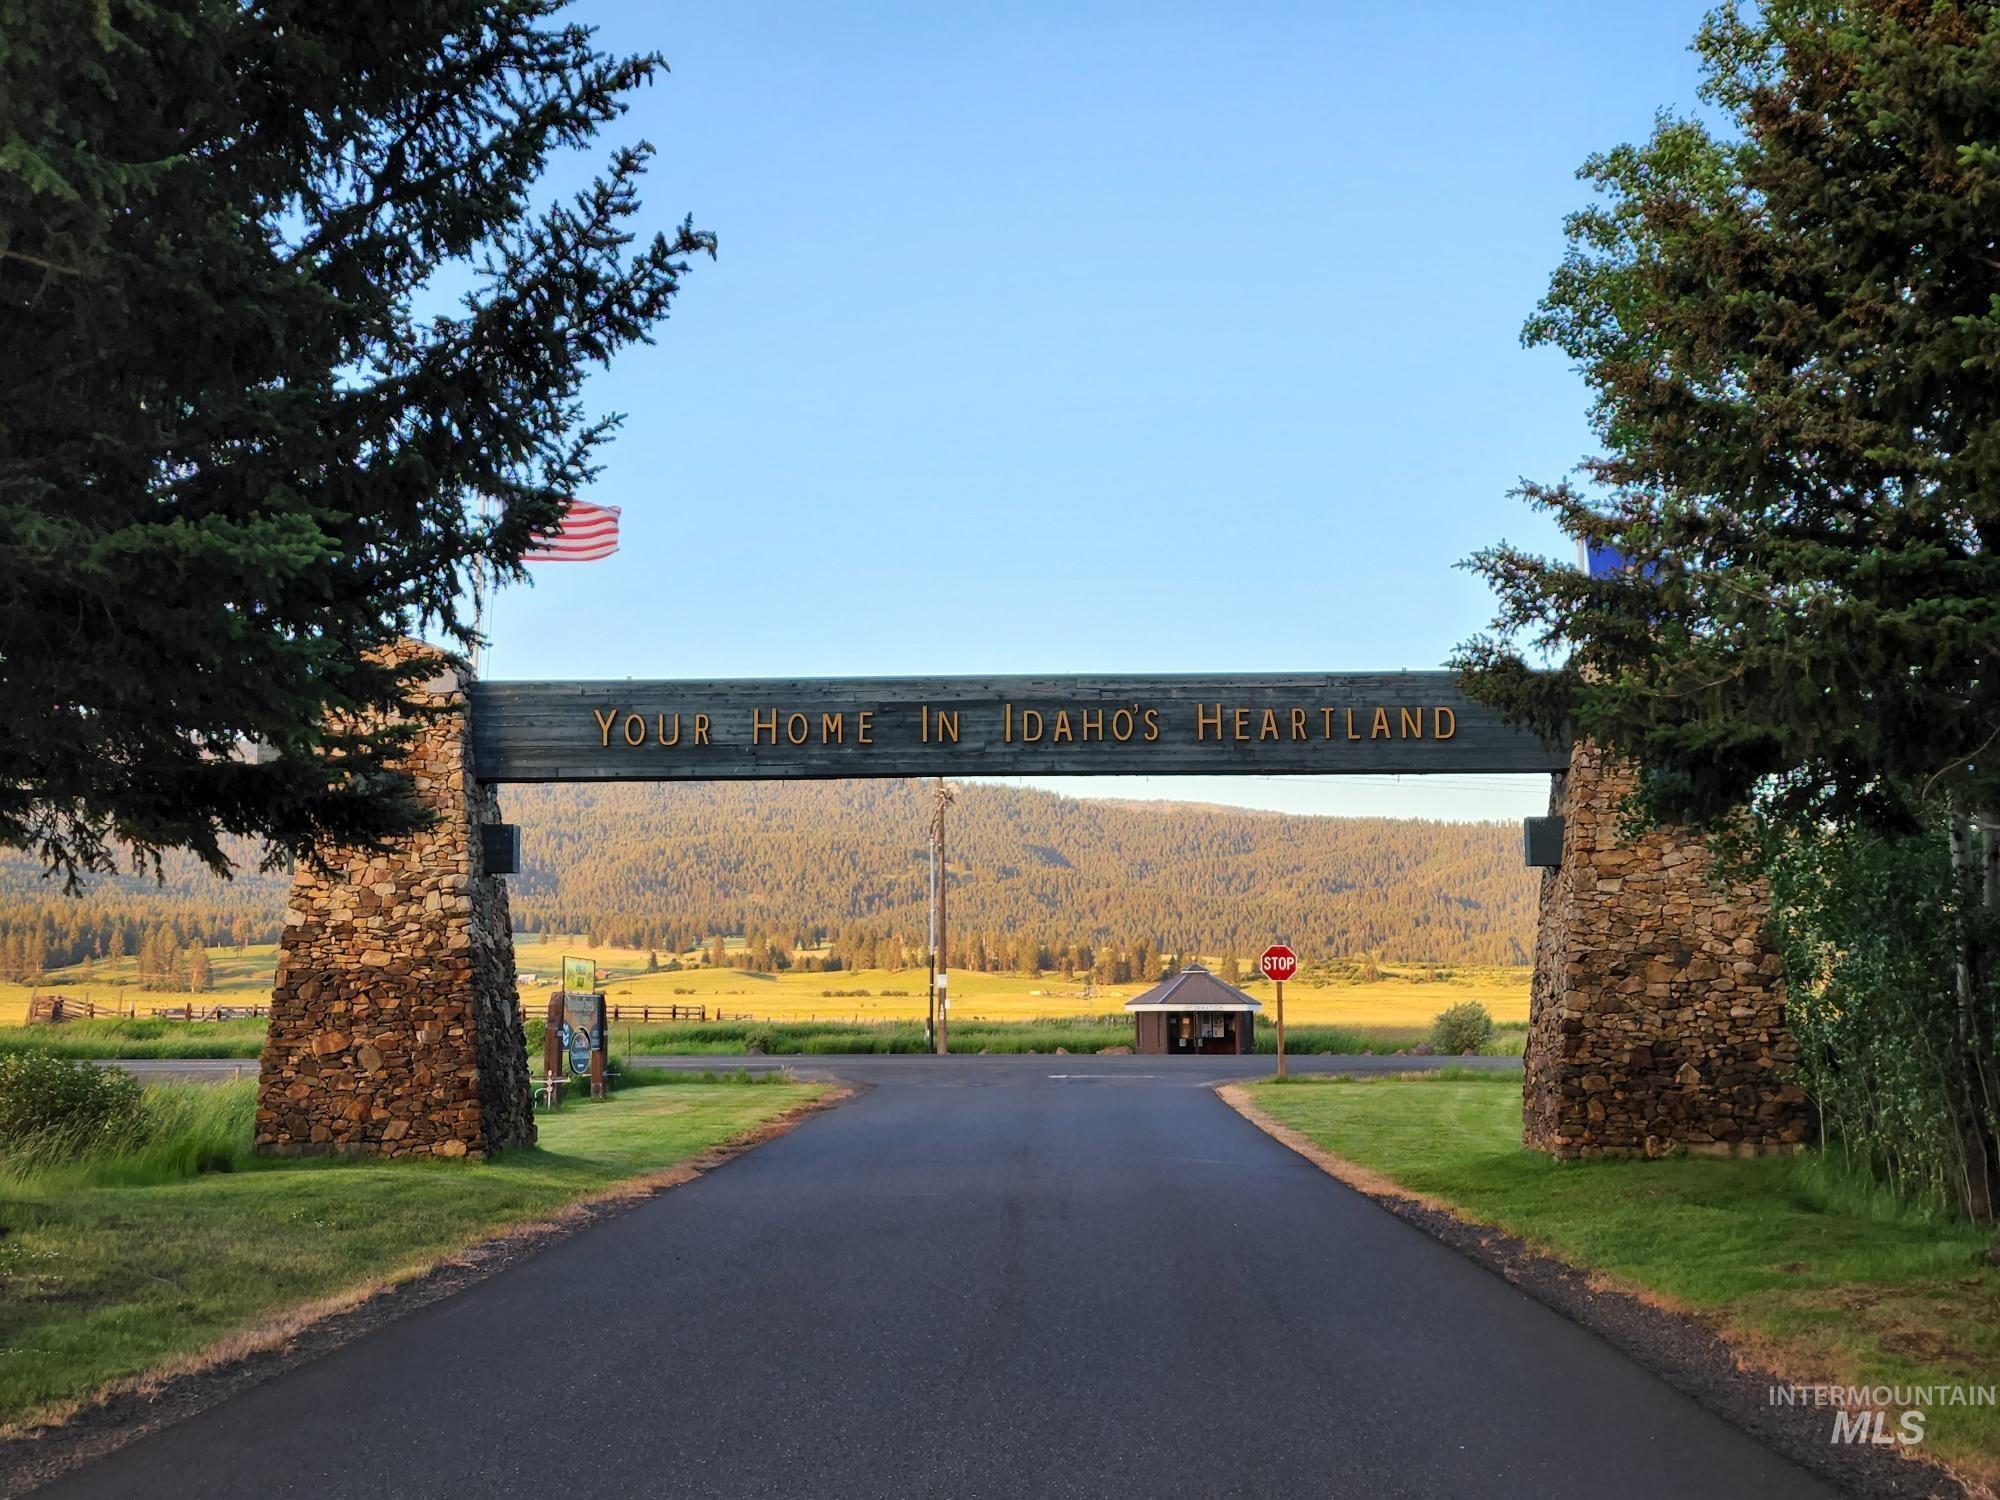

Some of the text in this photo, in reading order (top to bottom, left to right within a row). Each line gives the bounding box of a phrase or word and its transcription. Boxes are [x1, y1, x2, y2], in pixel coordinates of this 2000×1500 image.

[594, 702, 1457, 746] YOUR HOME IN IDAHO'S HEARTLAND
[1263, 956, 1295, 970] STOP
